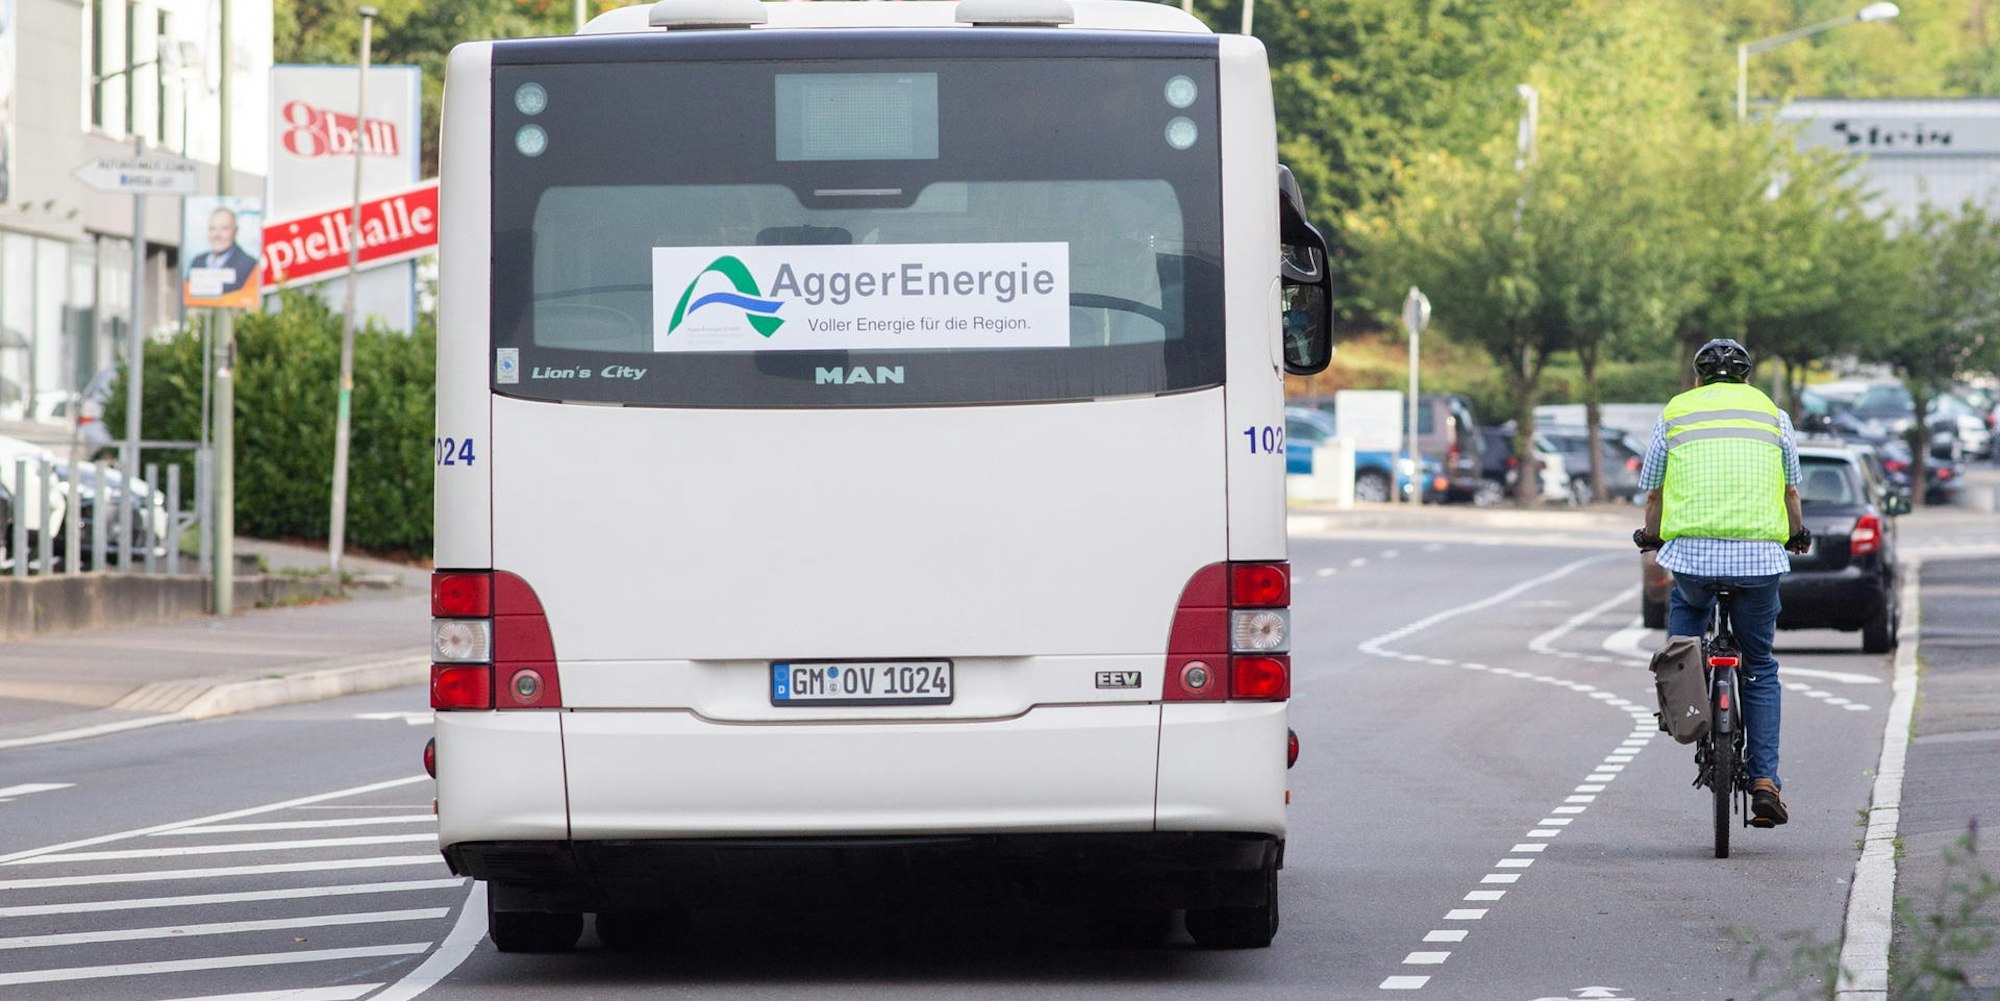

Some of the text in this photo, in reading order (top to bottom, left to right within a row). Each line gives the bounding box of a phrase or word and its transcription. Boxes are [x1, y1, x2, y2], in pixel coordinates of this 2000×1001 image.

[769, 261, 1055, 306] AggerEnergie
[808, 315, 1031, 334] Voller Energie für die Region.
[531, 365, 592, 379] Lion's
[600, 364, 648, 381] City
[815, 366, 905, 385] MAN
[792, 665, 947, 695] GM OV 1024
[1097, 671, 1140, 686] EEV
[778, 685, 786, 694] D
